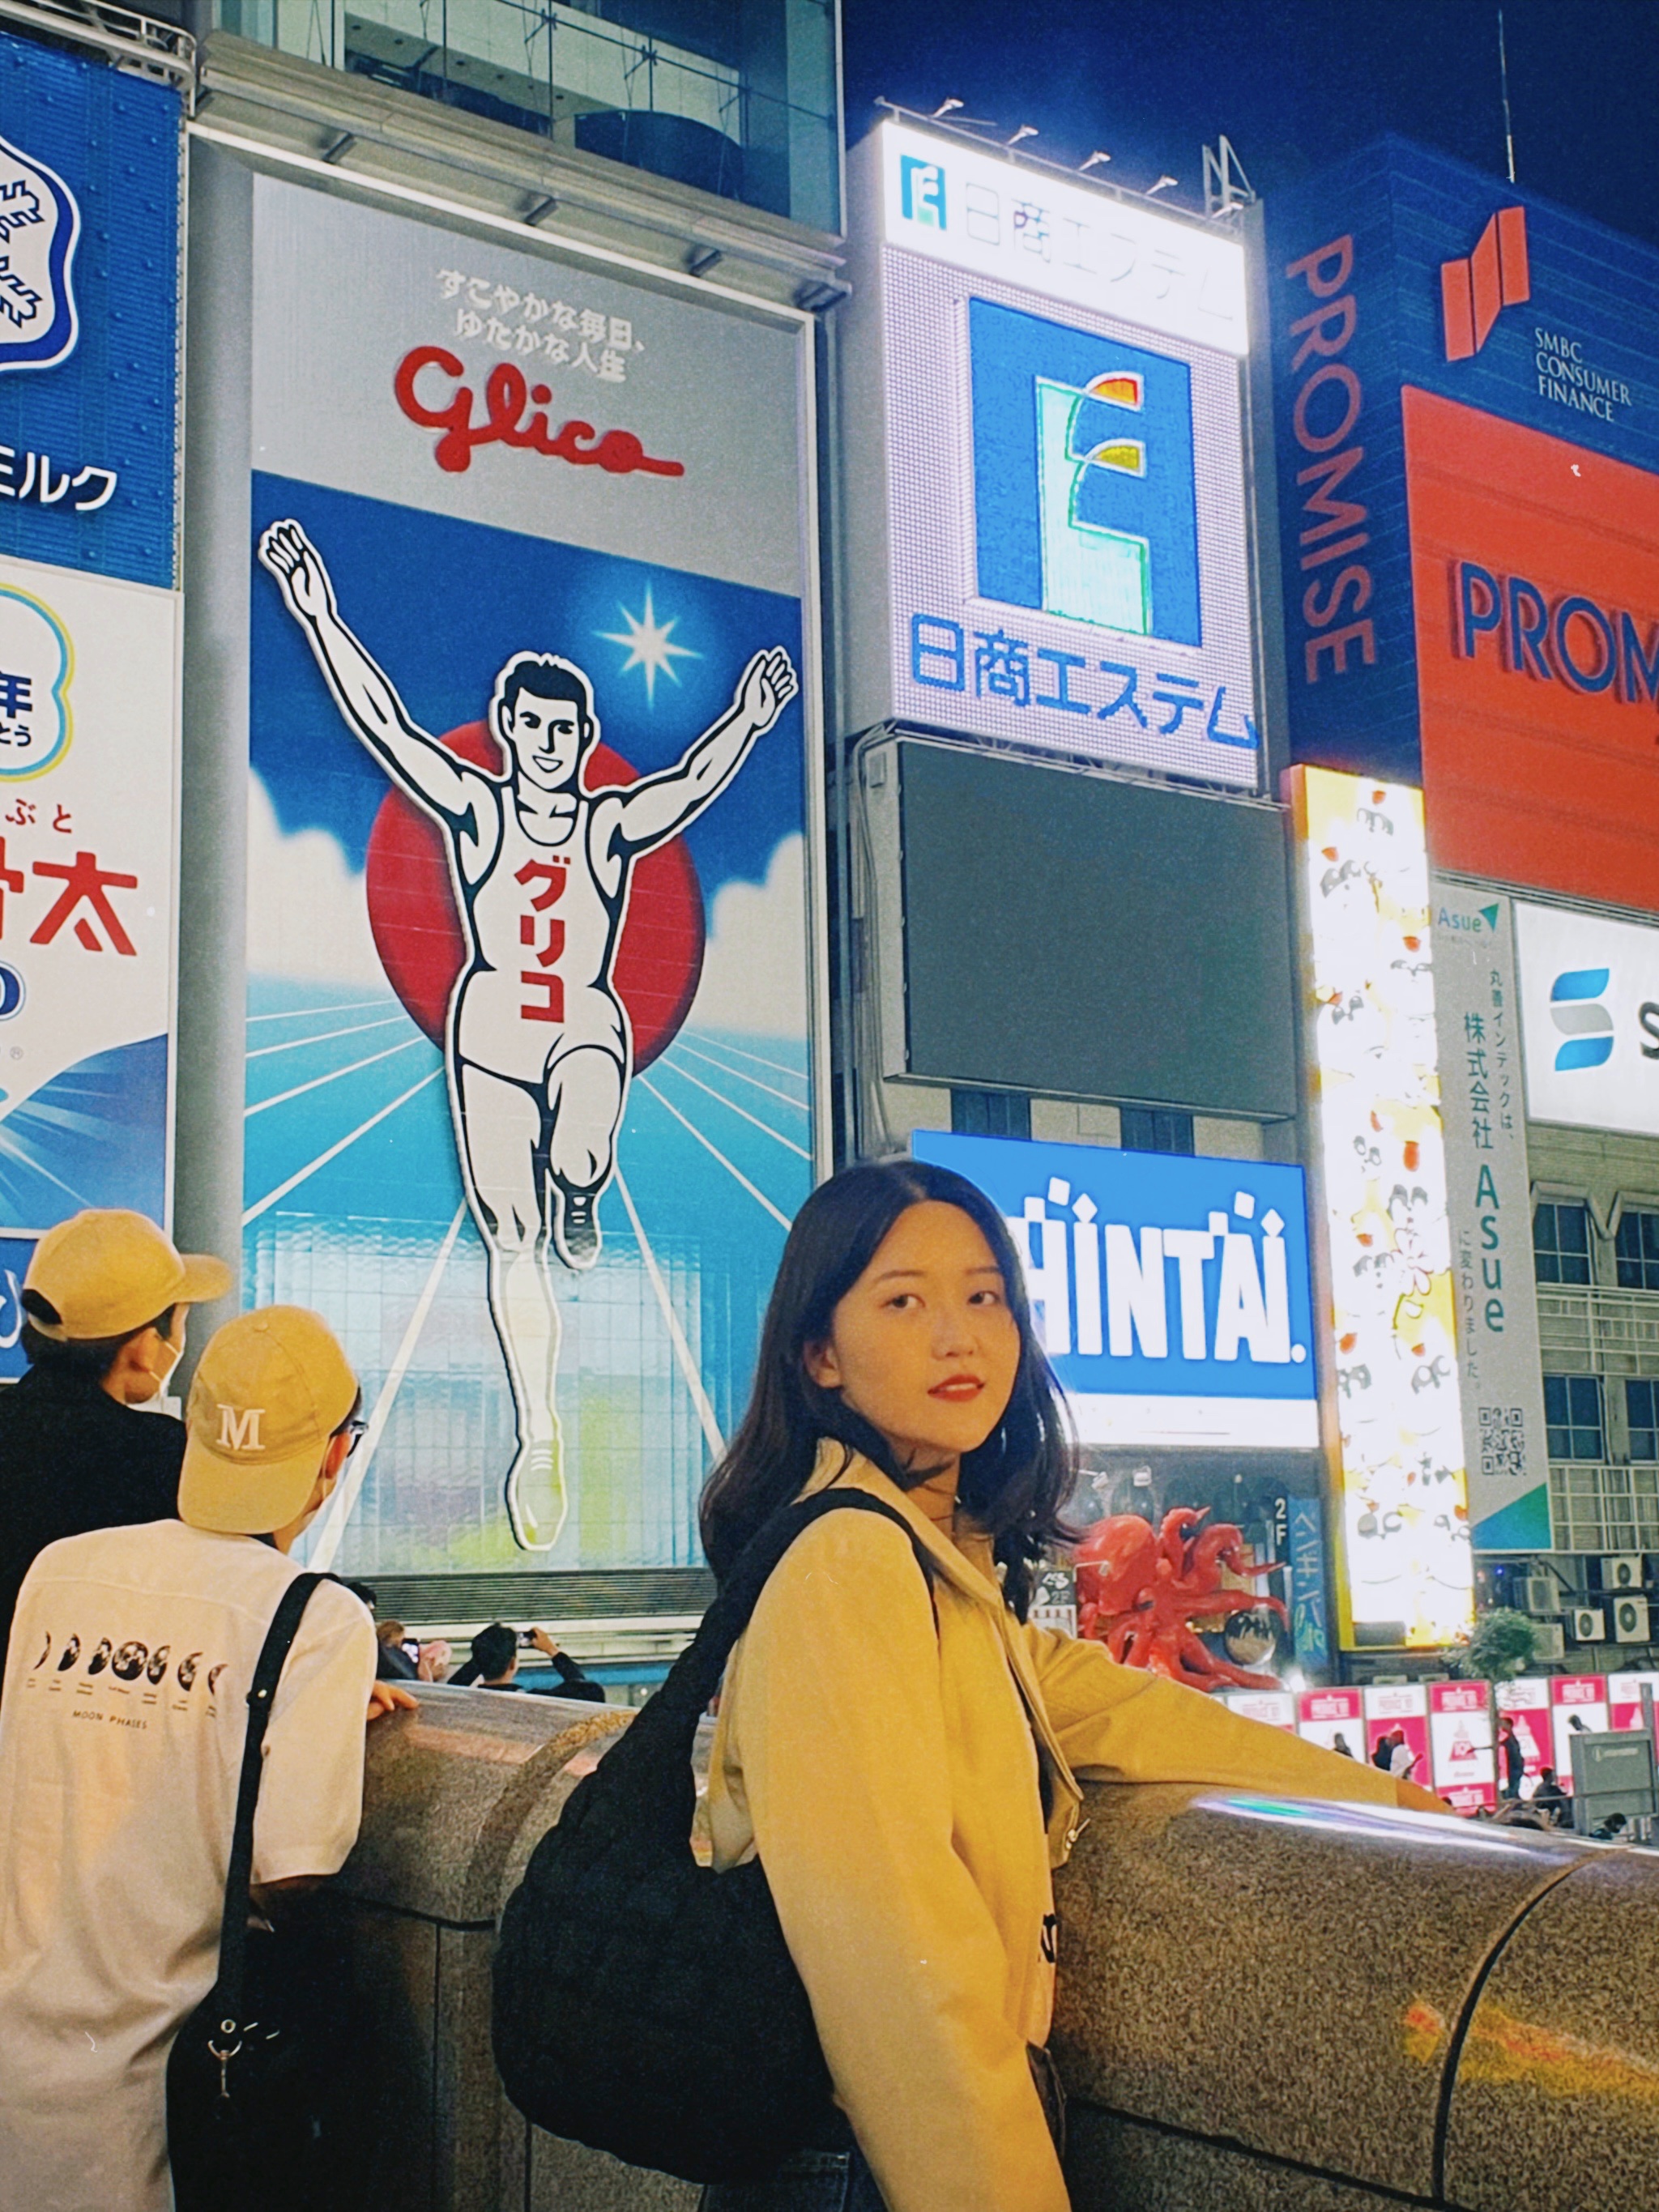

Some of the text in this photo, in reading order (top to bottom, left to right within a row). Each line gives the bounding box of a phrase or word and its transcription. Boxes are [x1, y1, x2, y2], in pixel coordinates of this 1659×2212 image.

[436, 269, 645, 352] すこやかな毎日、
[454, 309, 626, 383] ゆたかな人生
[1535, 327, 1582, 363] SMBC
[394, 345, 684, 476] Glico
[1536, 352, 1632, 407] CONSUMER
[1539, 375, 1614, 422] FINANCE
[1286, 234, 1375, 684] PROMISE
[911, 613, 1259, 749] 日商エステム
[514, 855, 570, 1023] グリコ
[1438, 907, 1482, 933] Asue
[1464, 1012, 1504, 1332] 株式会社 Asue
[216, 1404, 265, 1450] M
[1274, 1498, 1287, 1545] 2F
[72, 1710, 147, 1729] MOON PHASES
